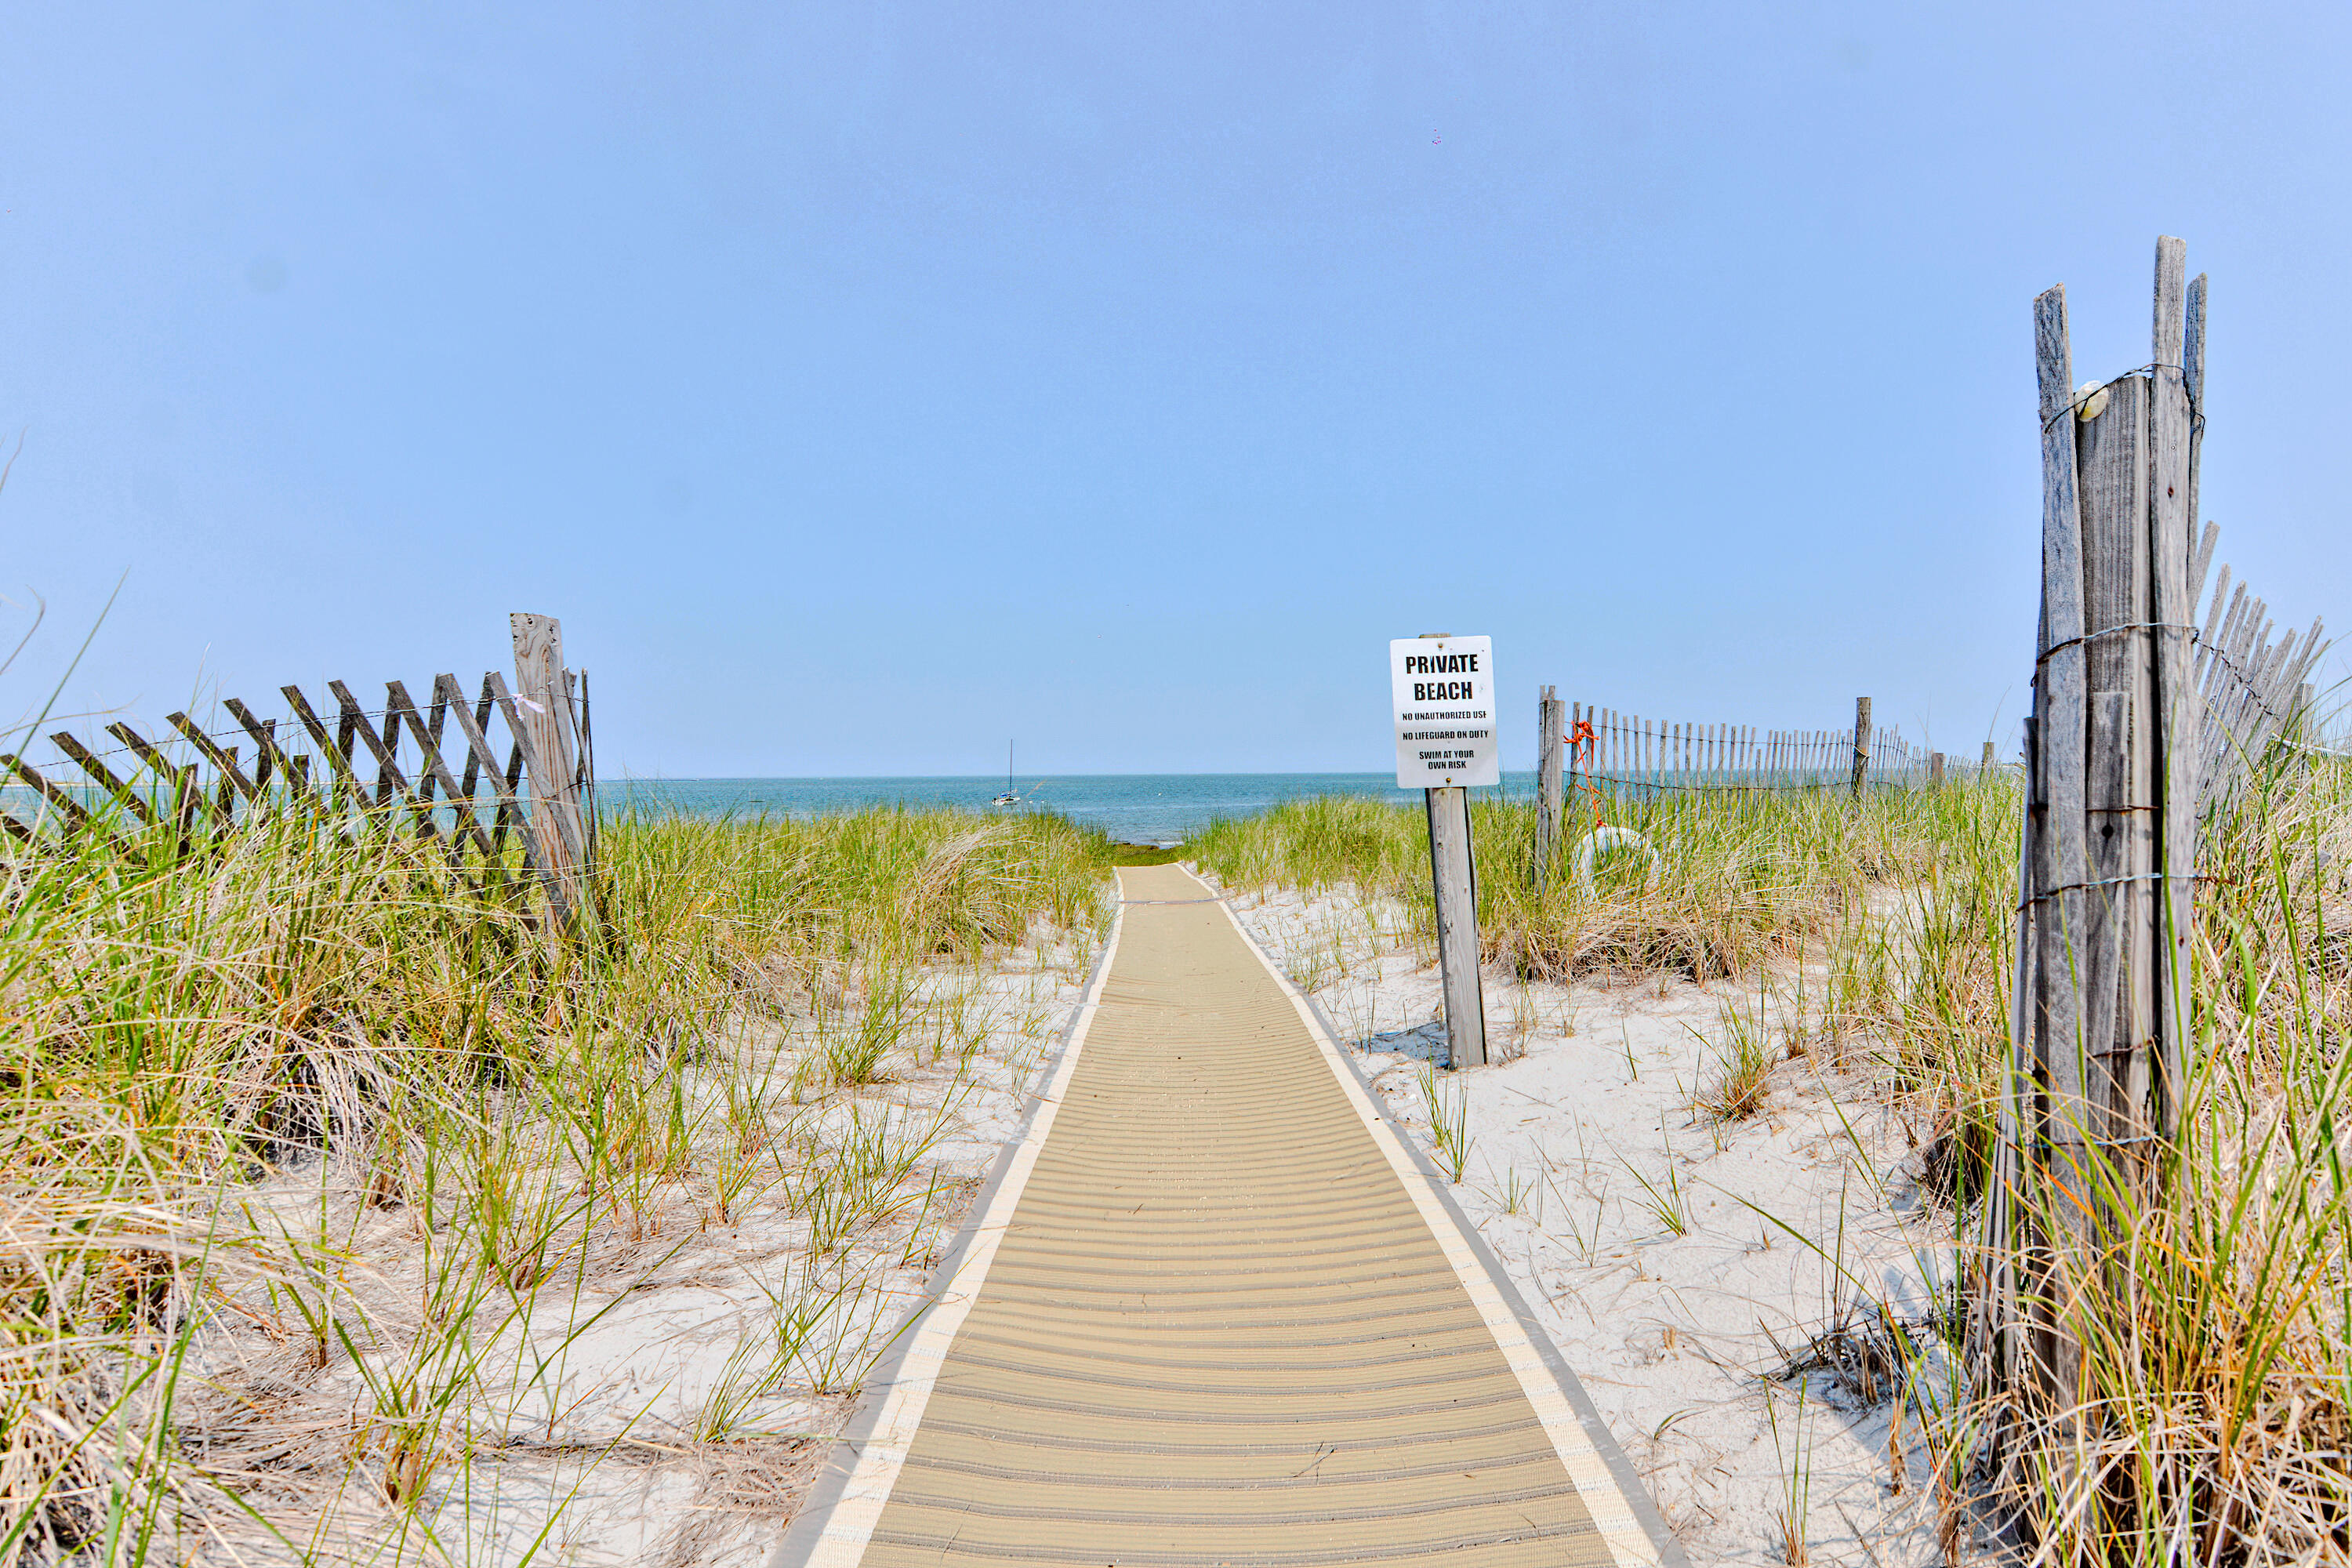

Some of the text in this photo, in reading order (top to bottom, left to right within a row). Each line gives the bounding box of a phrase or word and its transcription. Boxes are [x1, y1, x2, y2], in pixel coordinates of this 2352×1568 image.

[1406, 654, 1479, 674] PRIVATE
[1414, 681, 1473, 701] BEACH
[1414, 711, 1471, 720] UNAUTHORIZED
[1414, 731, 1455, 740] LIFEGUARD
[1469, 730, 1489, 739] DUTY
[1419, 750, 1442, 760] SWIM
[1443, 750, 1452, 759] AT
[1428, 761, 1446, 770] OWN
